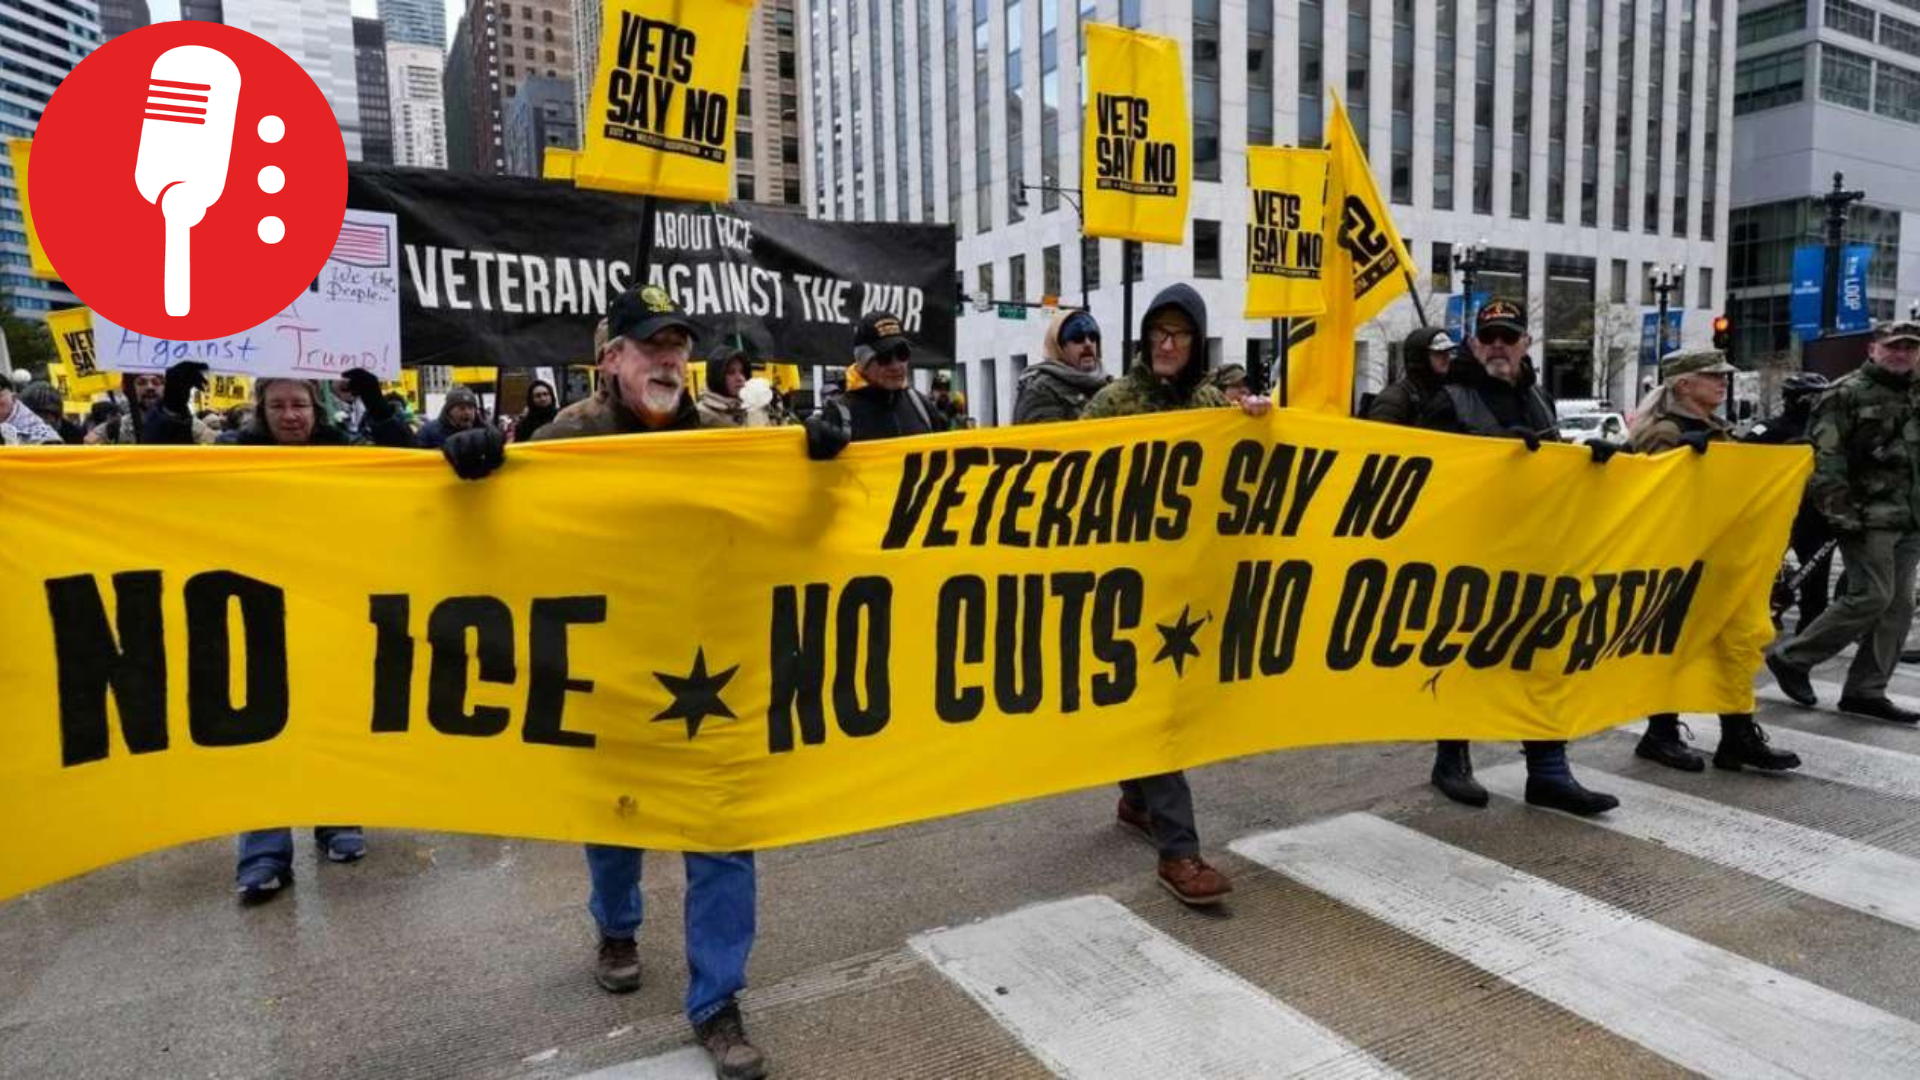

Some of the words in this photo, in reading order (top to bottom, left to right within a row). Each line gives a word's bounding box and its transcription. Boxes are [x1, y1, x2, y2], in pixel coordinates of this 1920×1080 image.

[617, 10, 696, 84] VETS
[607, 69, 675, 134] SAY
[683, 88, 728, 146] NO
[1097, 92, 1149, 140] VETS
[1097, 136, 1136, 180] SAY
[1144, 142, 1176, 184] NO
[655, 211, 713, 250] ABOUT
[1254, 189, 1301, 230] VETS
[1254, 227, 1289, 265] SAY
[1297, 231, 1323, 268] NO
[404, 244, 630, 315] VETERANS
[648, 262, 783, 318] AGAINST
[794, 273, 852, 324] THE
[861, 283, 924, 333] WAR
[117, 328, 256, 366] Against
[275, 324, 390, 373] Trump!
[881, 440, 1203, 550] VETERANS
[1217, 439, 1339, 537] SAY
[1333, 453, 1433, 540] NO
[44, 569, 290, 768] NO
[368, 592, 608, 748] ICE
[768, 574, 893, 754] NO
[934, 566, 1144, 724] CUTS
[1218, 559, 1314, 683] NO
[1325, 557, 1706, 676] OCCUPATION
